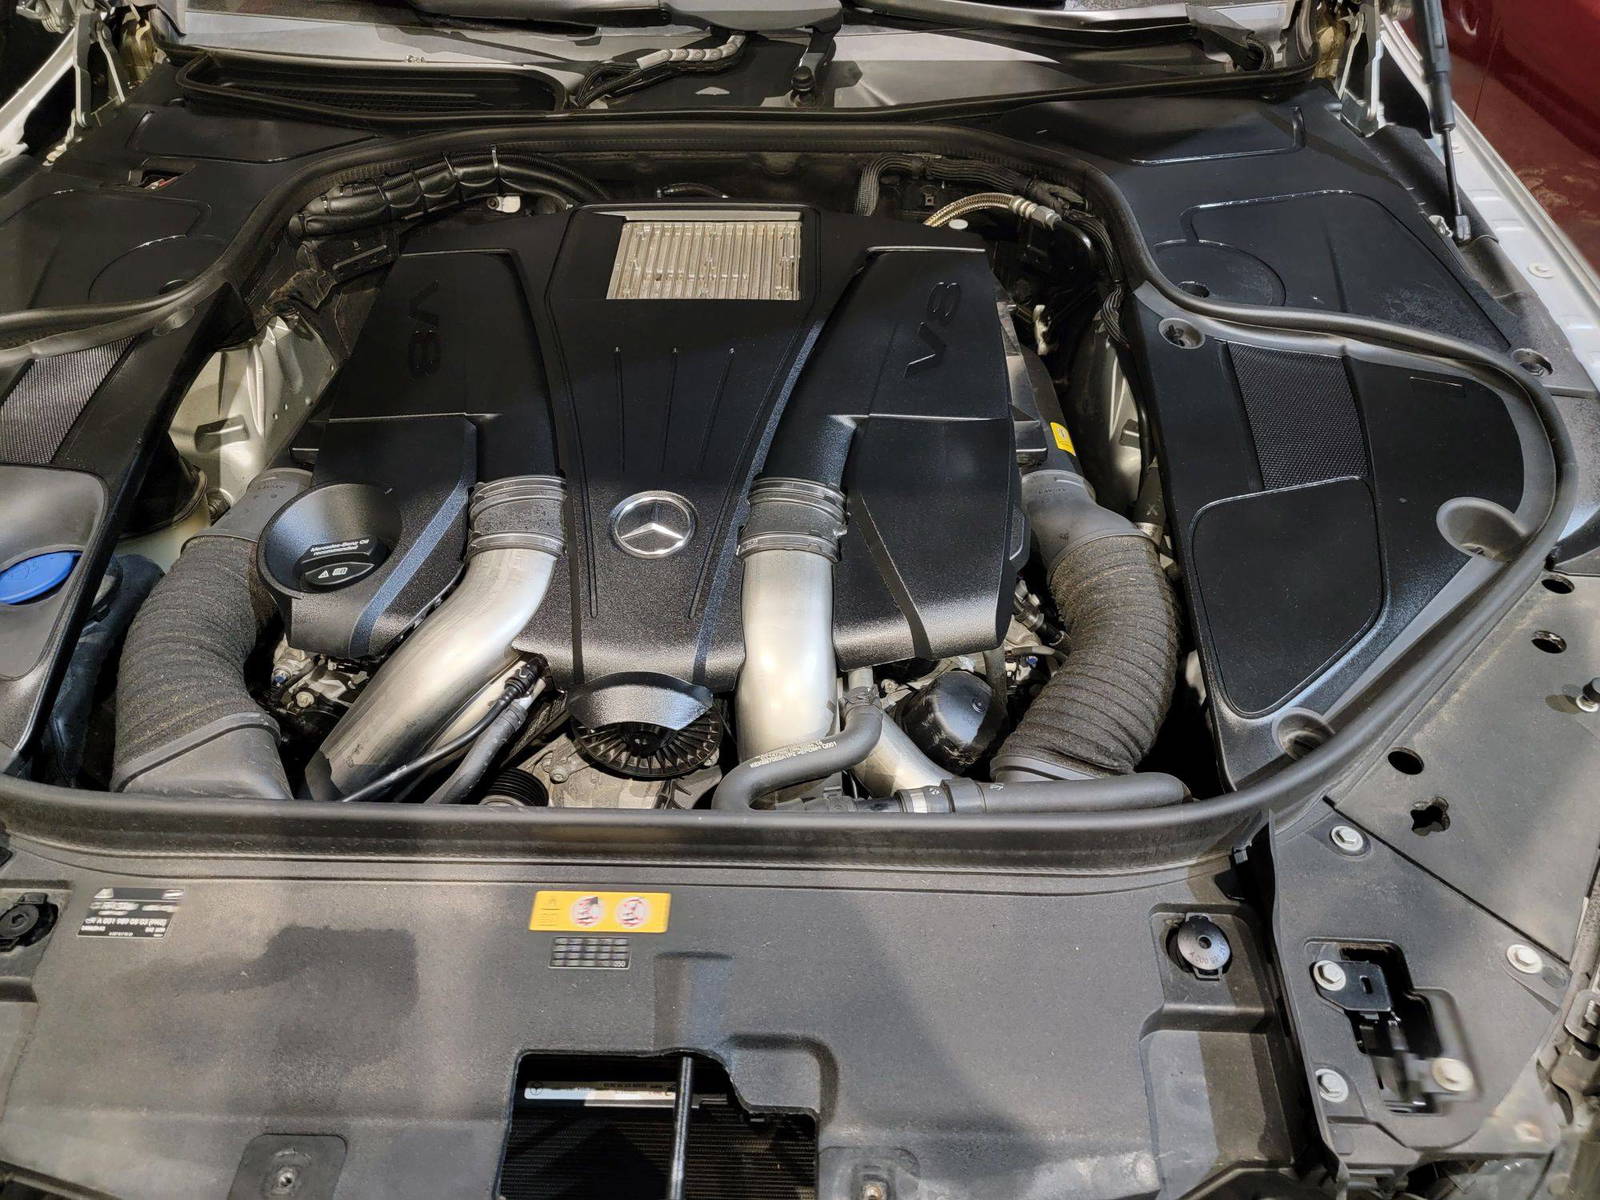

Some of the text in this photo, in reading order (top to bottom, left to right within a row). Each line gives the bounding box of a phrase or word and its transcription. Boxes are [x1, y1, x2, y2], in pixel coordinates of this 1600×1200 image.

[408, 279, 442, 377] V8
[903, 282, 961, 378] V8
[310, 542, 358, 552] Mercedes-Benz
